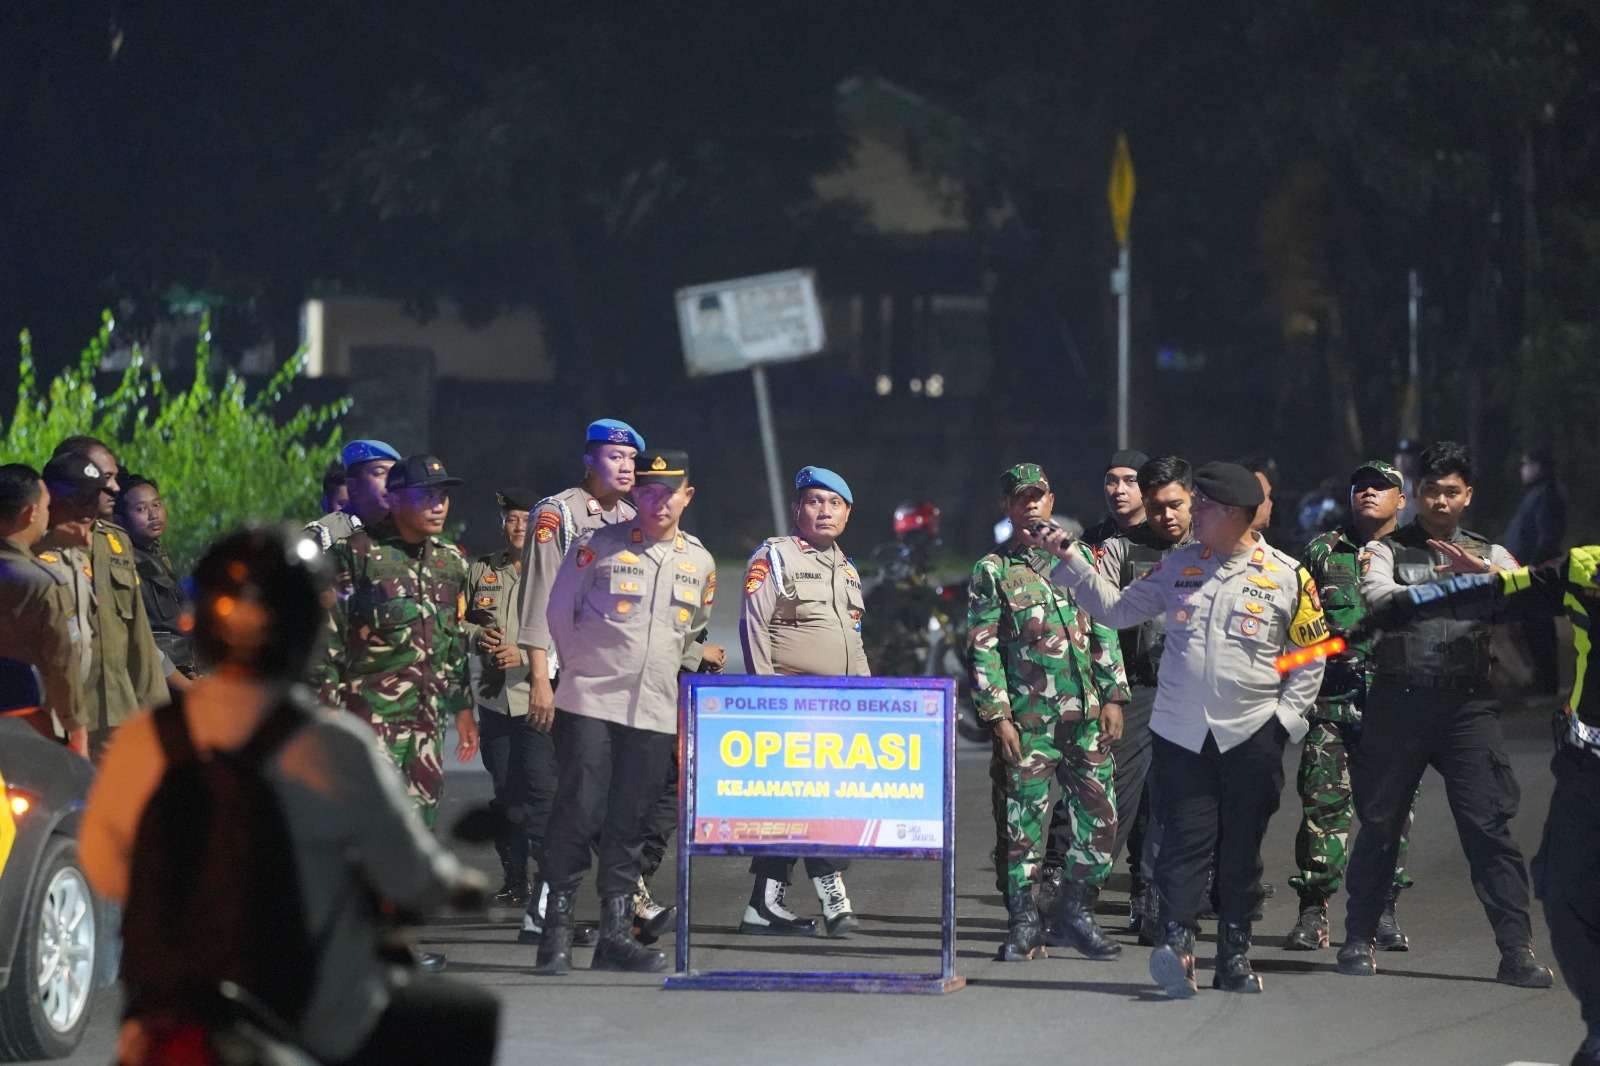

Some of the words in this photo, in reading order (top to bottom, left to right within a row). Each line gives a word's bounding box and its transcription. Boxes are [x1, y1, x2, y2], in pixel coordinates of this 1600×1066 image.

[675, 573, 700, 585] POLRI
[1242, 586, 1275, 602] POLRI
[724, 696, 788, 711] POLRES
[794, 698, 851, 713] METRO
[857, 698, 918, 713] BEKASI
[719, 730, 921, 770] OPERASI
[716, 779, 830, 798] KEJAHATAN
[834, 781, 924, 800] JALANAN
[734, 822, 809, 839] PRESISI
